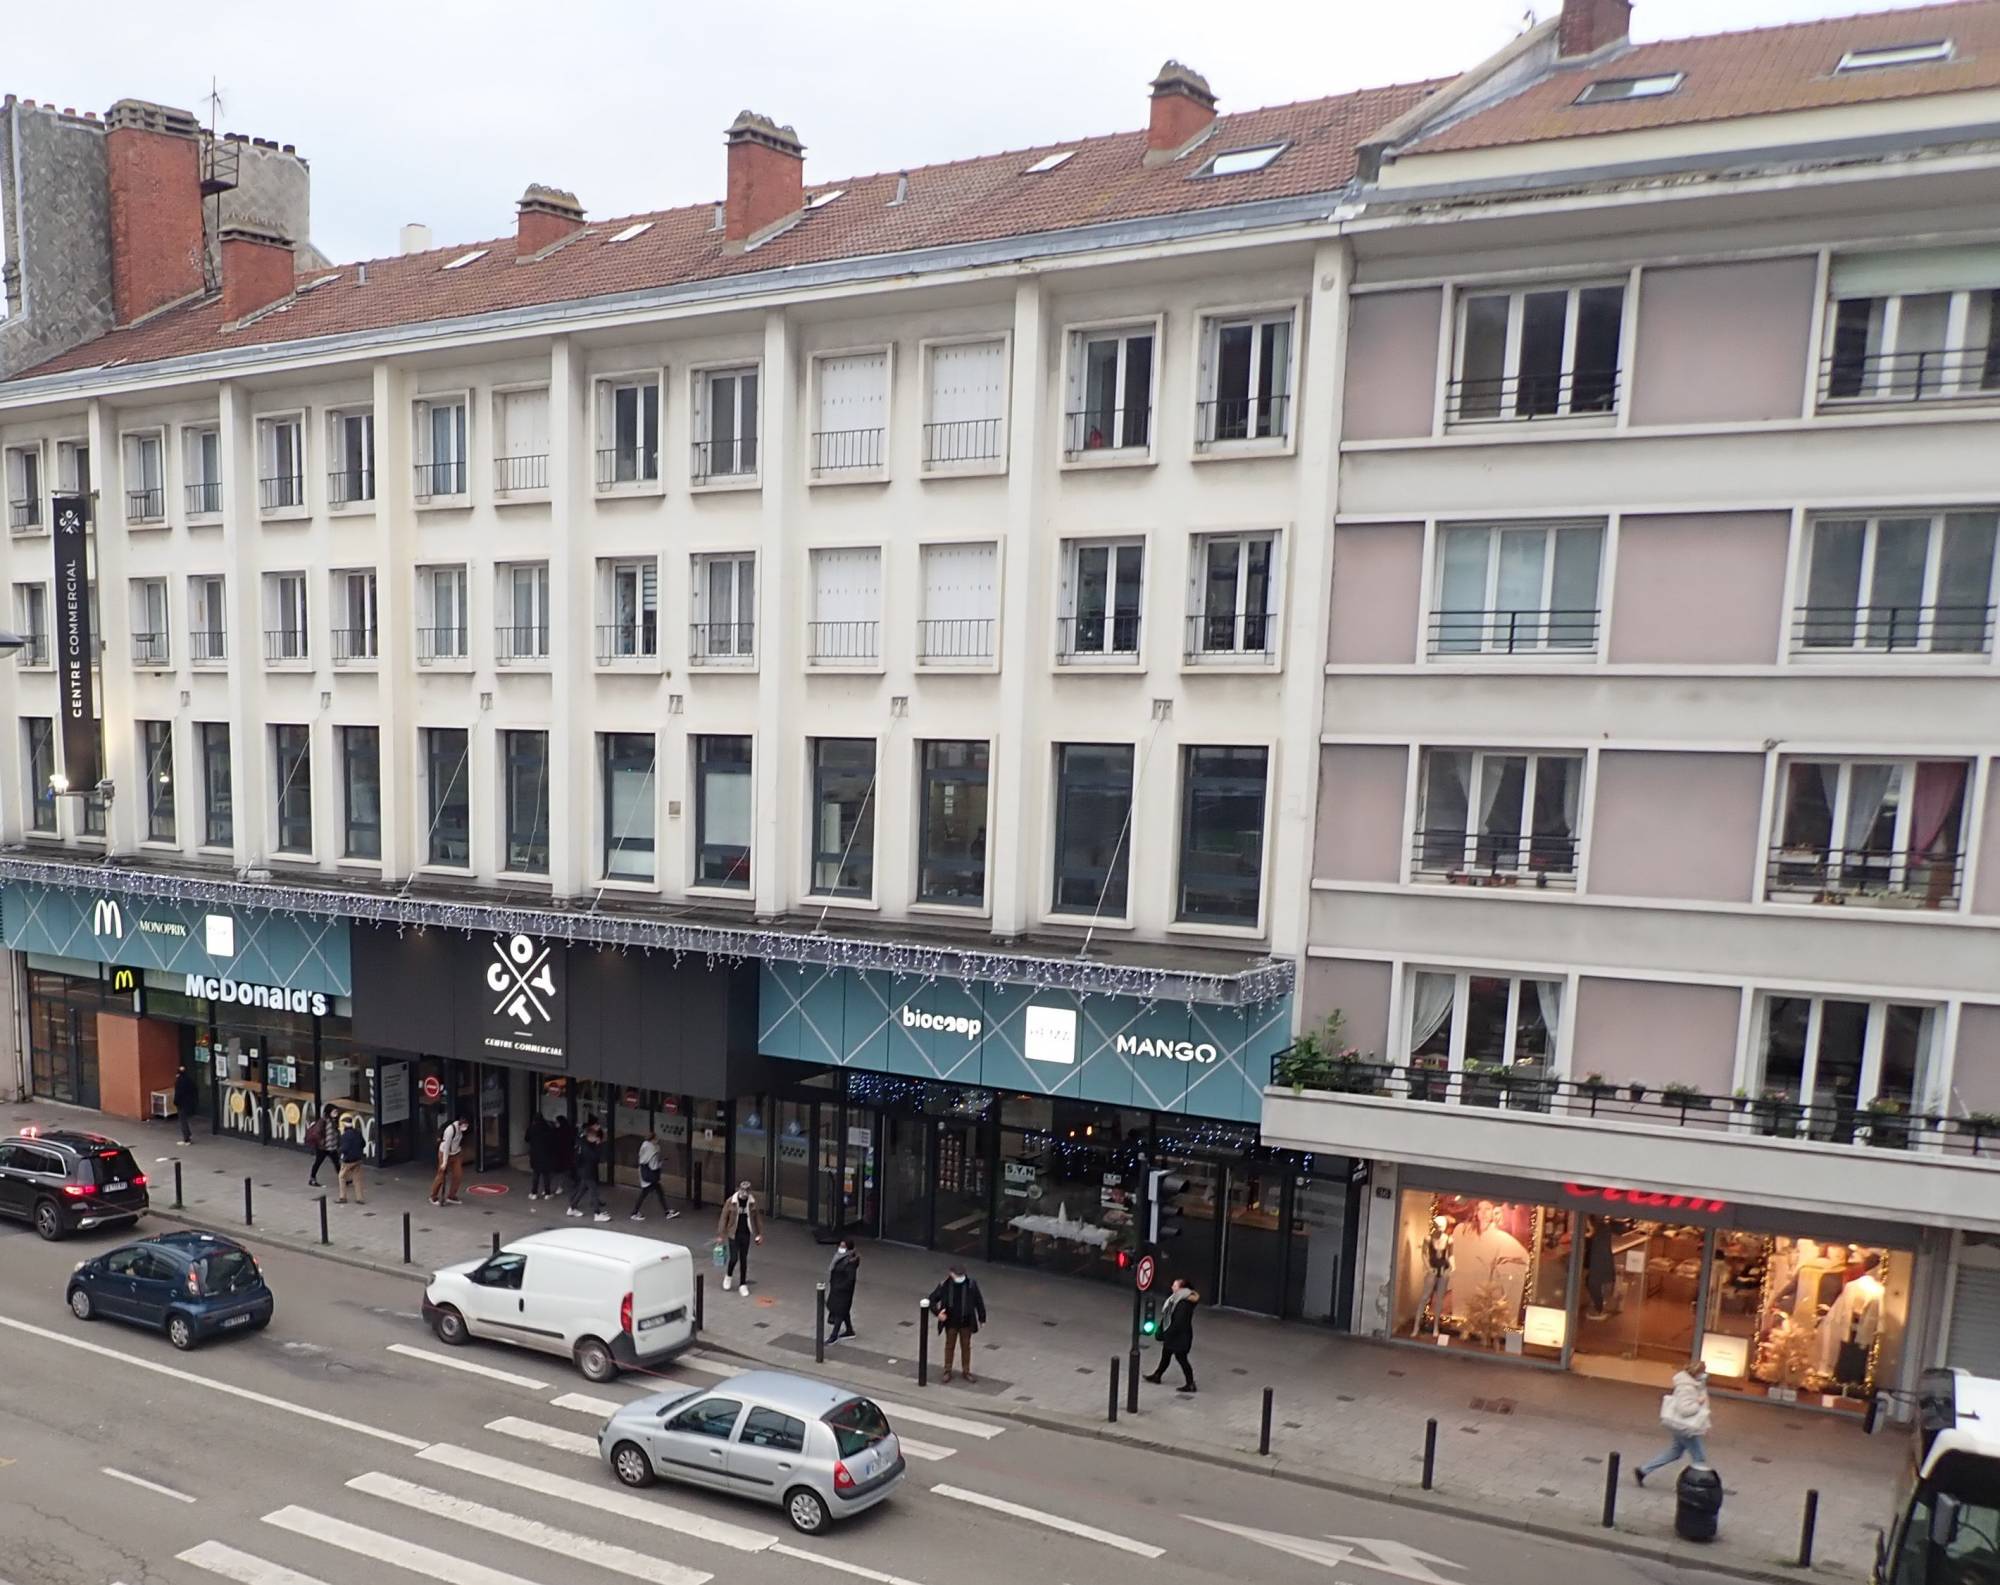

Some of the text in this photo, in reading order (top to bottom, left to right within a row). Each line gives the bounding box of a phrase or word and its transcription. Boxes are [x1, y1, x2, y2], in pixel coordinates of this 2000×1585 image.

[67, 560, 82, 718] CENTRE COMMERCIAL
[139, 919, 187, 937] MONOPRIX
[185, 973, 326, 1017] McDonald's
[484, 1037, 563, 1057] CENTRE COMMERCIAL
[1116, 1033, 1217, 1064] MANGO
